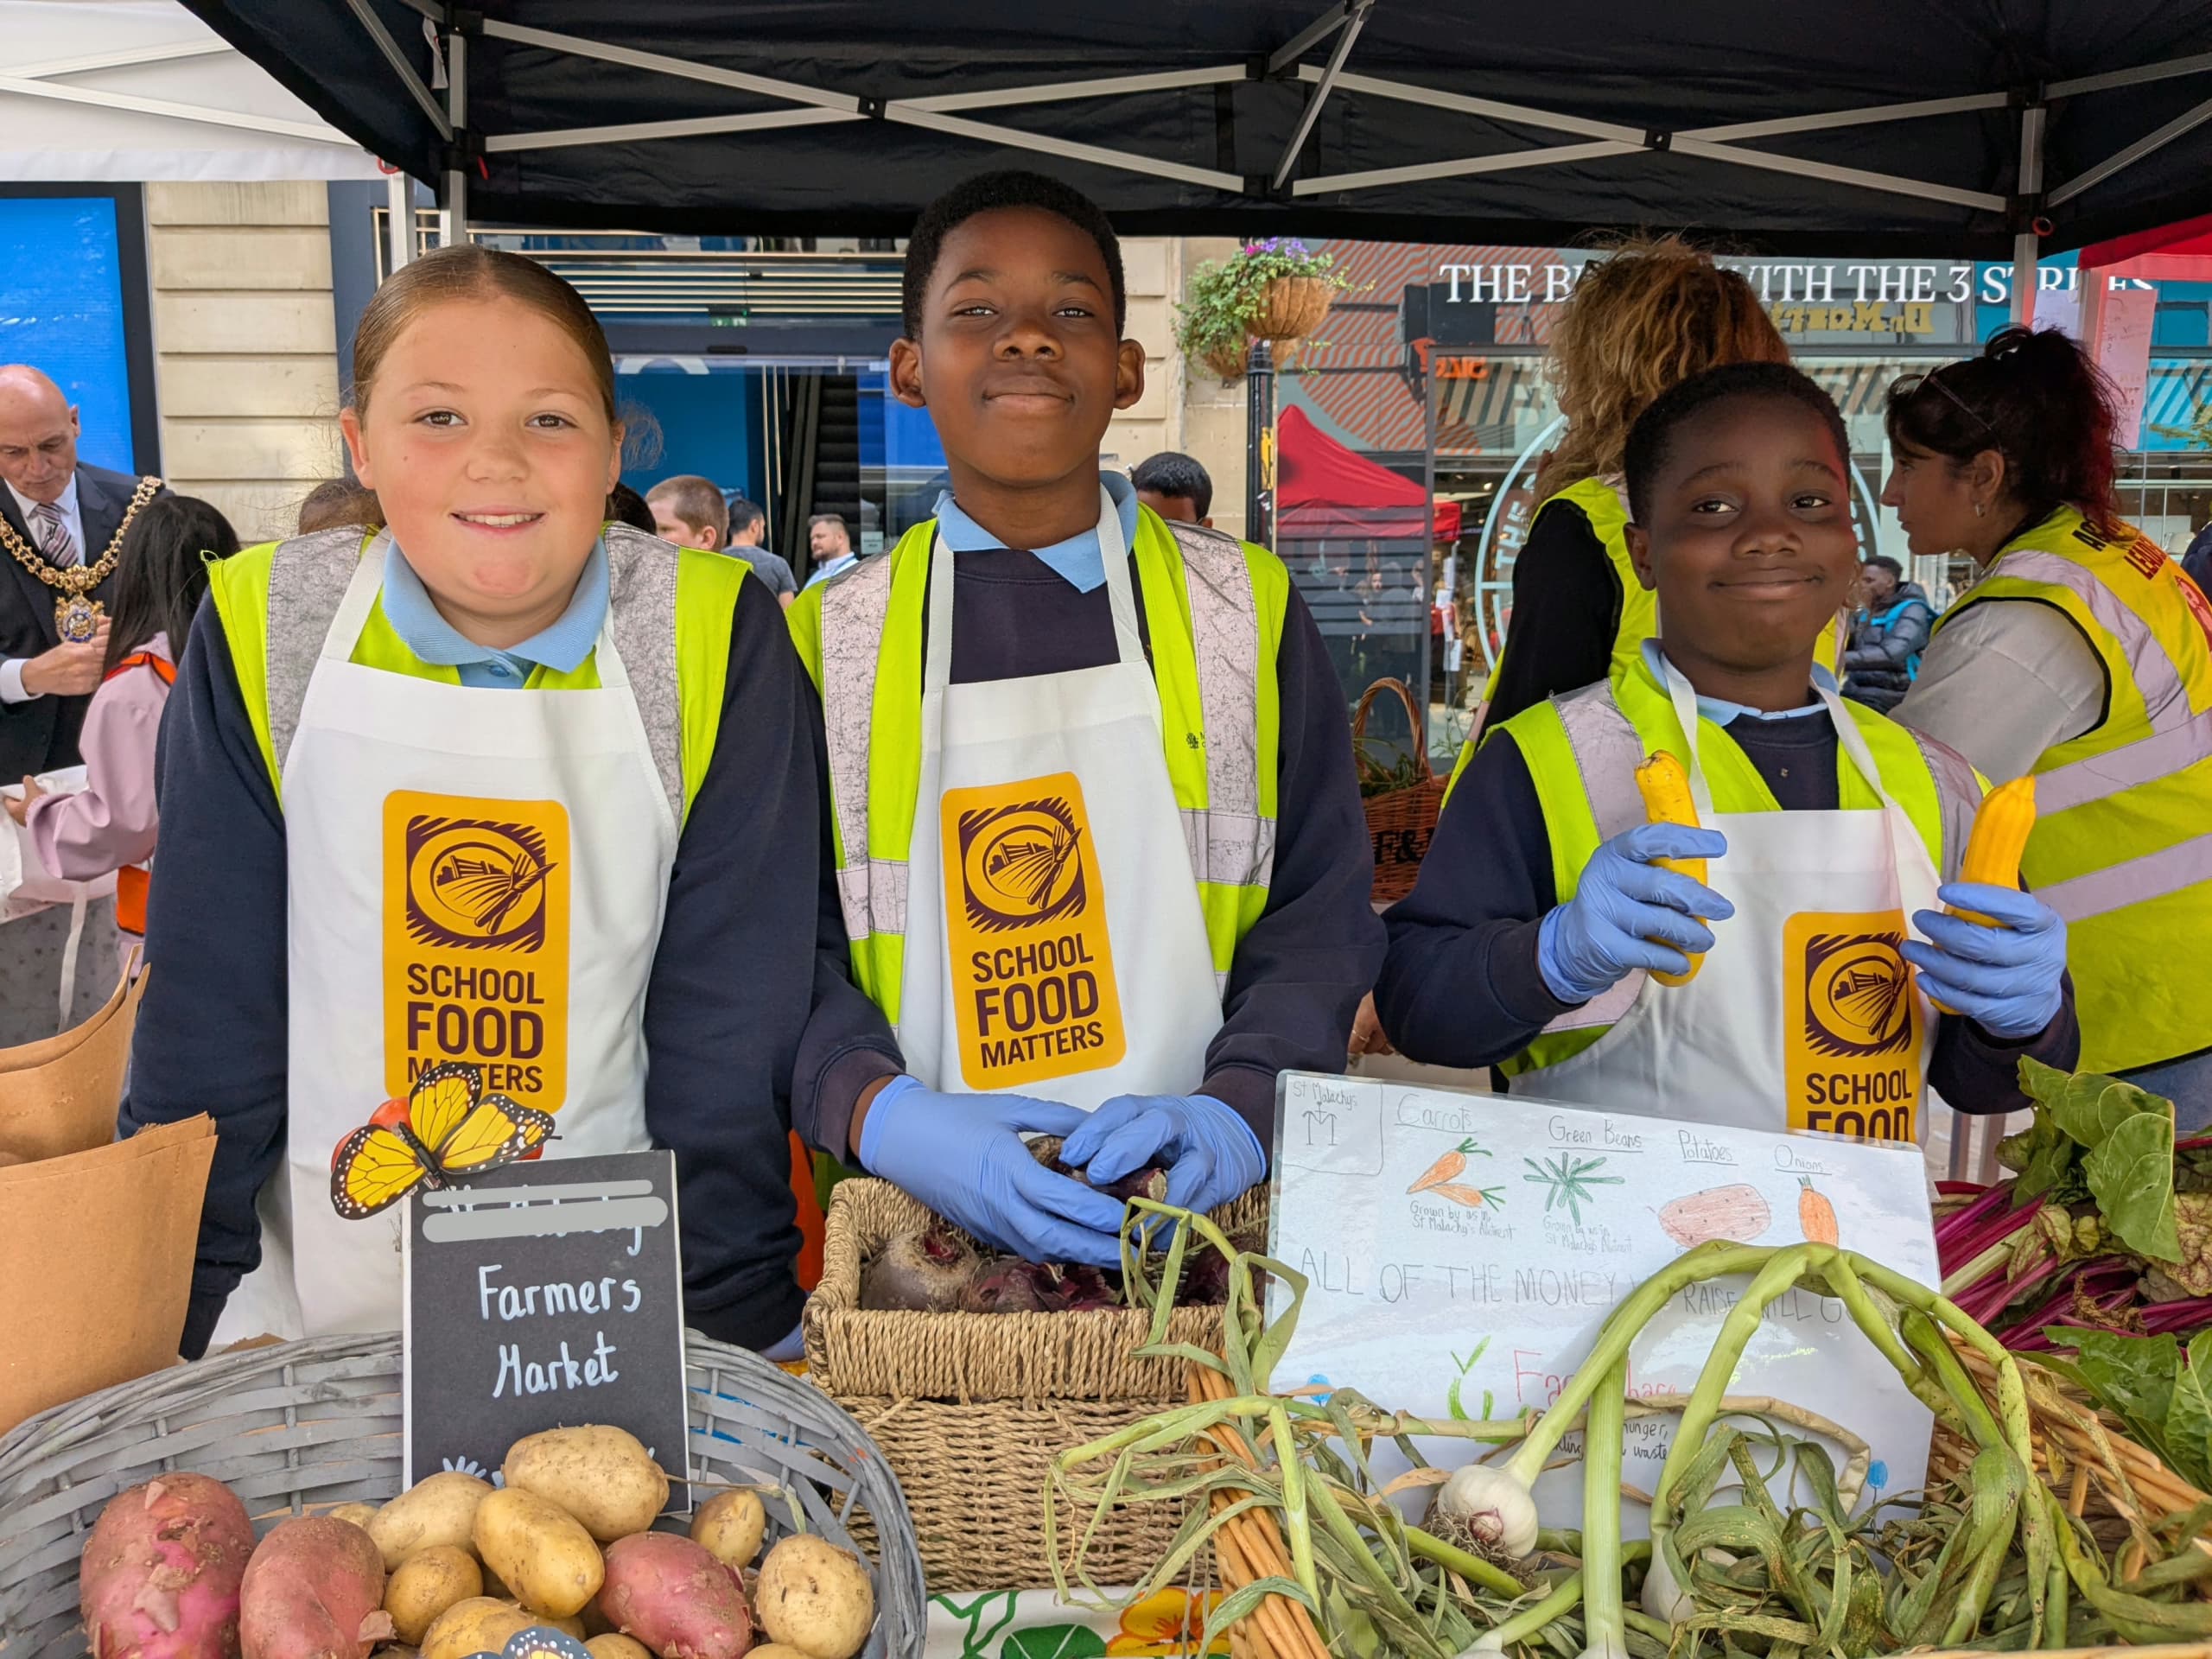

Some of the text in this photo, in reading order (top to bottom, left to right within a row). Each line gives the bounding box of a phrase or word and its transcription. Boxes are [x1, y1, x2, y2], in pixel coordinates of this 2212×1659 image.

[1439, 264, 1532, 302] THE
[1846, 265, 1937, 302] THE
[1947, 266, 1972, 302] 3
[972, 933, 1094, 982] SCHOOL
[407, 963, 545, 1005] SCHOOL
[975, 970, 1100, 1037] FOOD
[407, 1001, 544, 1060] FOOD
[980, 1021, 1105, 1069] MATTERS
[1806, 1068, 1913, 1105] SCHOOL
[1397, 1092, 1472, 1134] Carrots
[1548, 1115, 1643, 1148] Green Beans
[1677, 1128, 1733, 1162] Potatoes
[1774, 1144, 1826, 1173] Onions
[1409, 1199, 1445, 1217] Grown
[1412, 1214, 1426, 1229] St
[478, 1263, 642, 1320] Farmers
[1293, 1248, 1364, 1295] ALL
[1379, 1263, 1425, 1304] OF
[1434, 1264, 1503, 1303] THE
[1515, 1267, 1618, 1307] MONEY
[492, 1331, 620, 1399] Market
